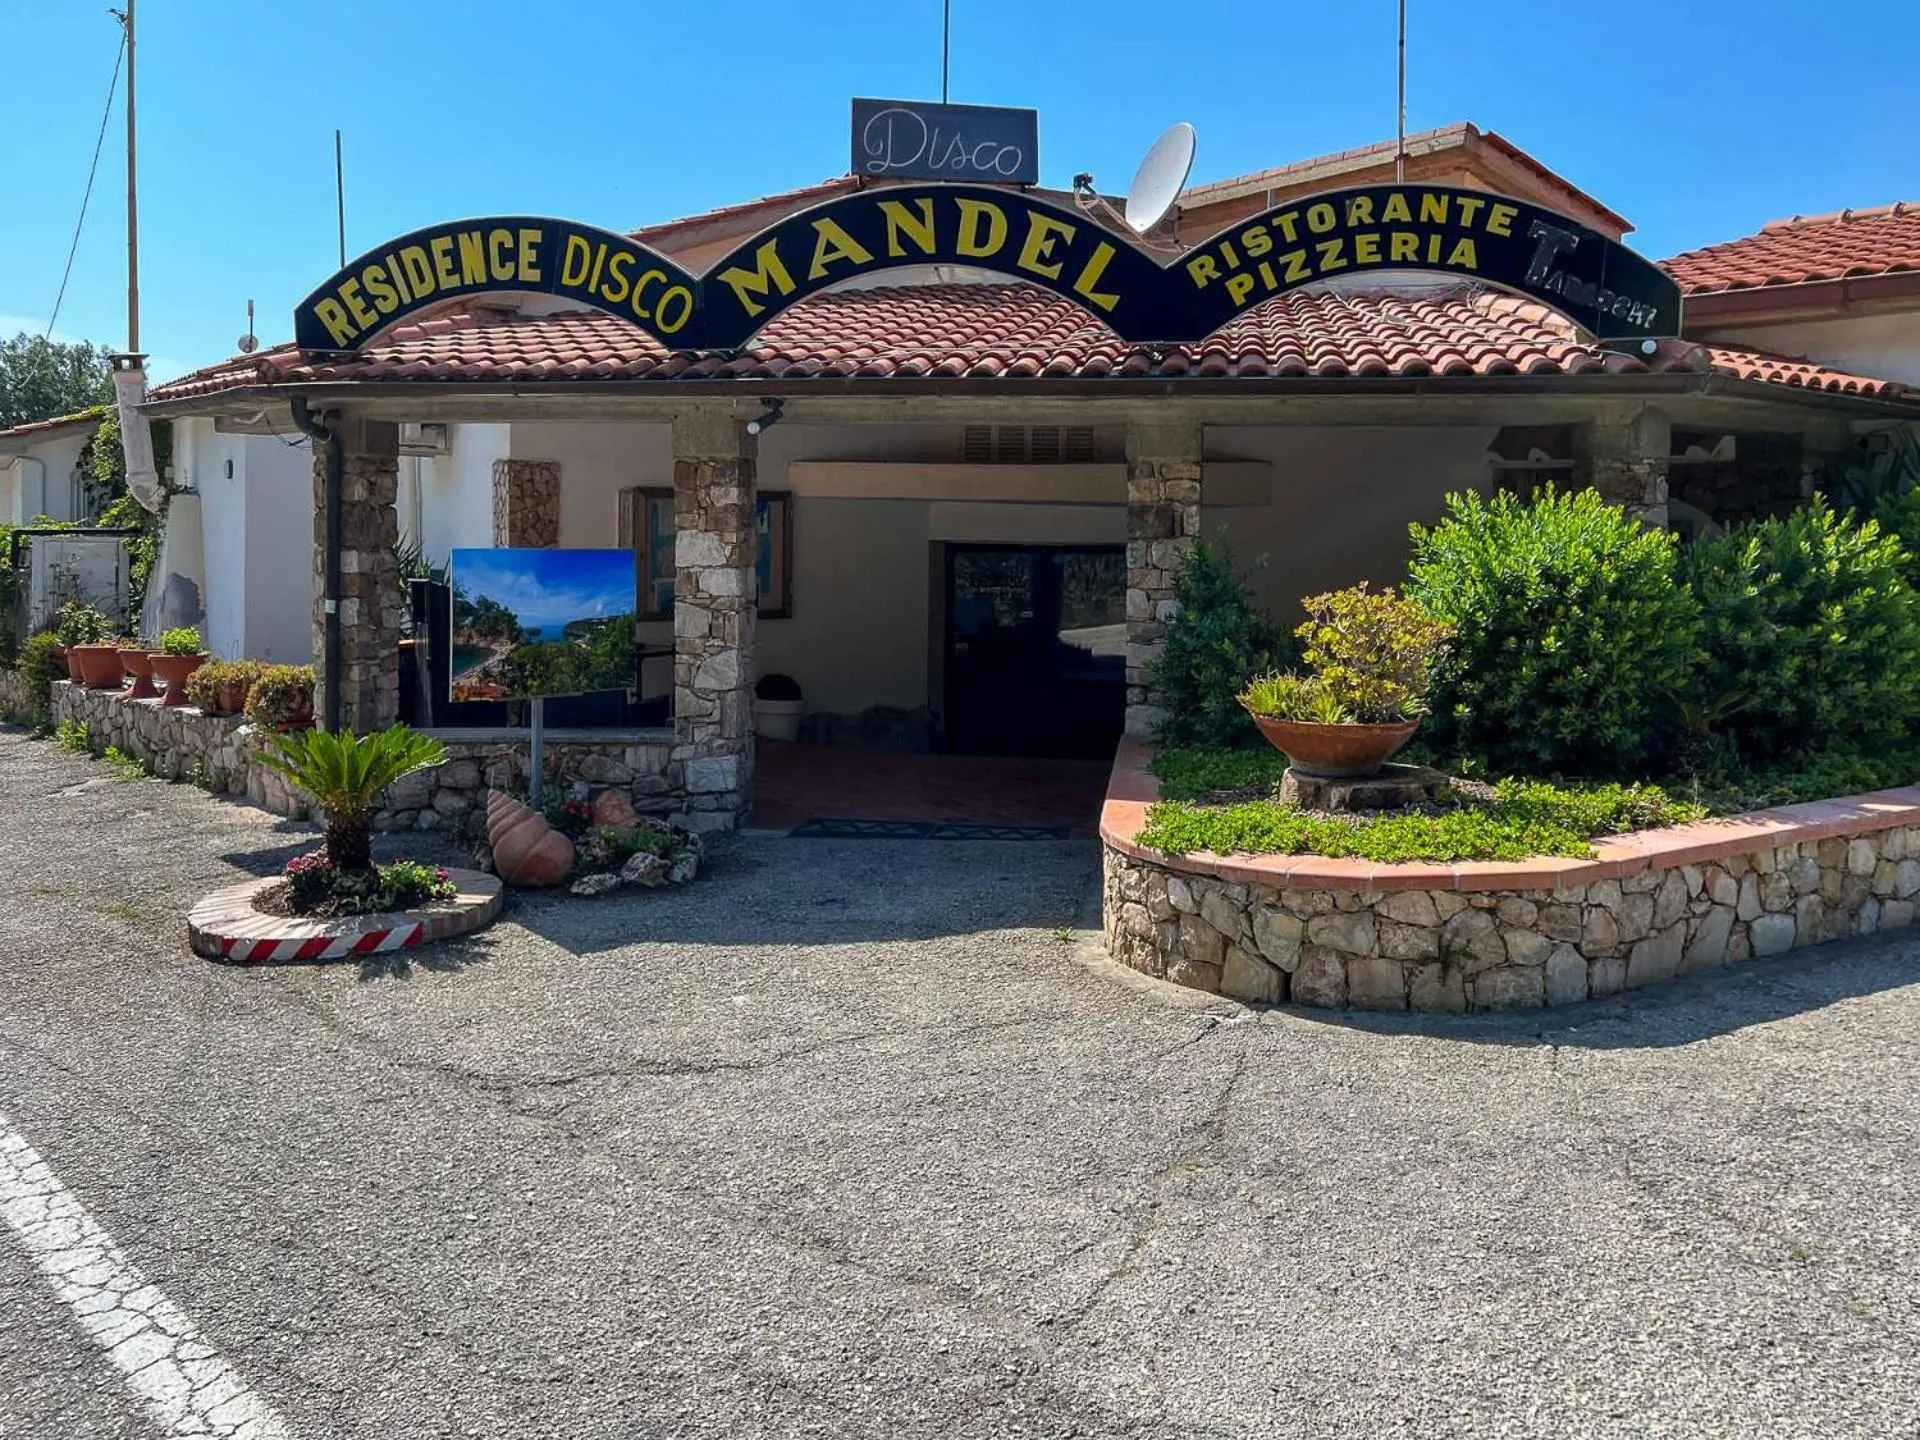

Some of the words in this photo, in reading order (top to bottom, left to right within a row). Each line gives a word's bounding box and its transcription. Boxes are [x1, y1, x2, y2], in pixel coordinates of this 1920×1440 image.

[864, 108, 1022, 175] Disco
[314, 228, 543, 348] RESIDENCE
[561, 234, 693, 334] DISCO
[716, 198, 1121, 317] MANDEL
[1185, 193, 1520, 289] RISTORANTE
[1224, 233, 1478, 307] PIZZERIA
